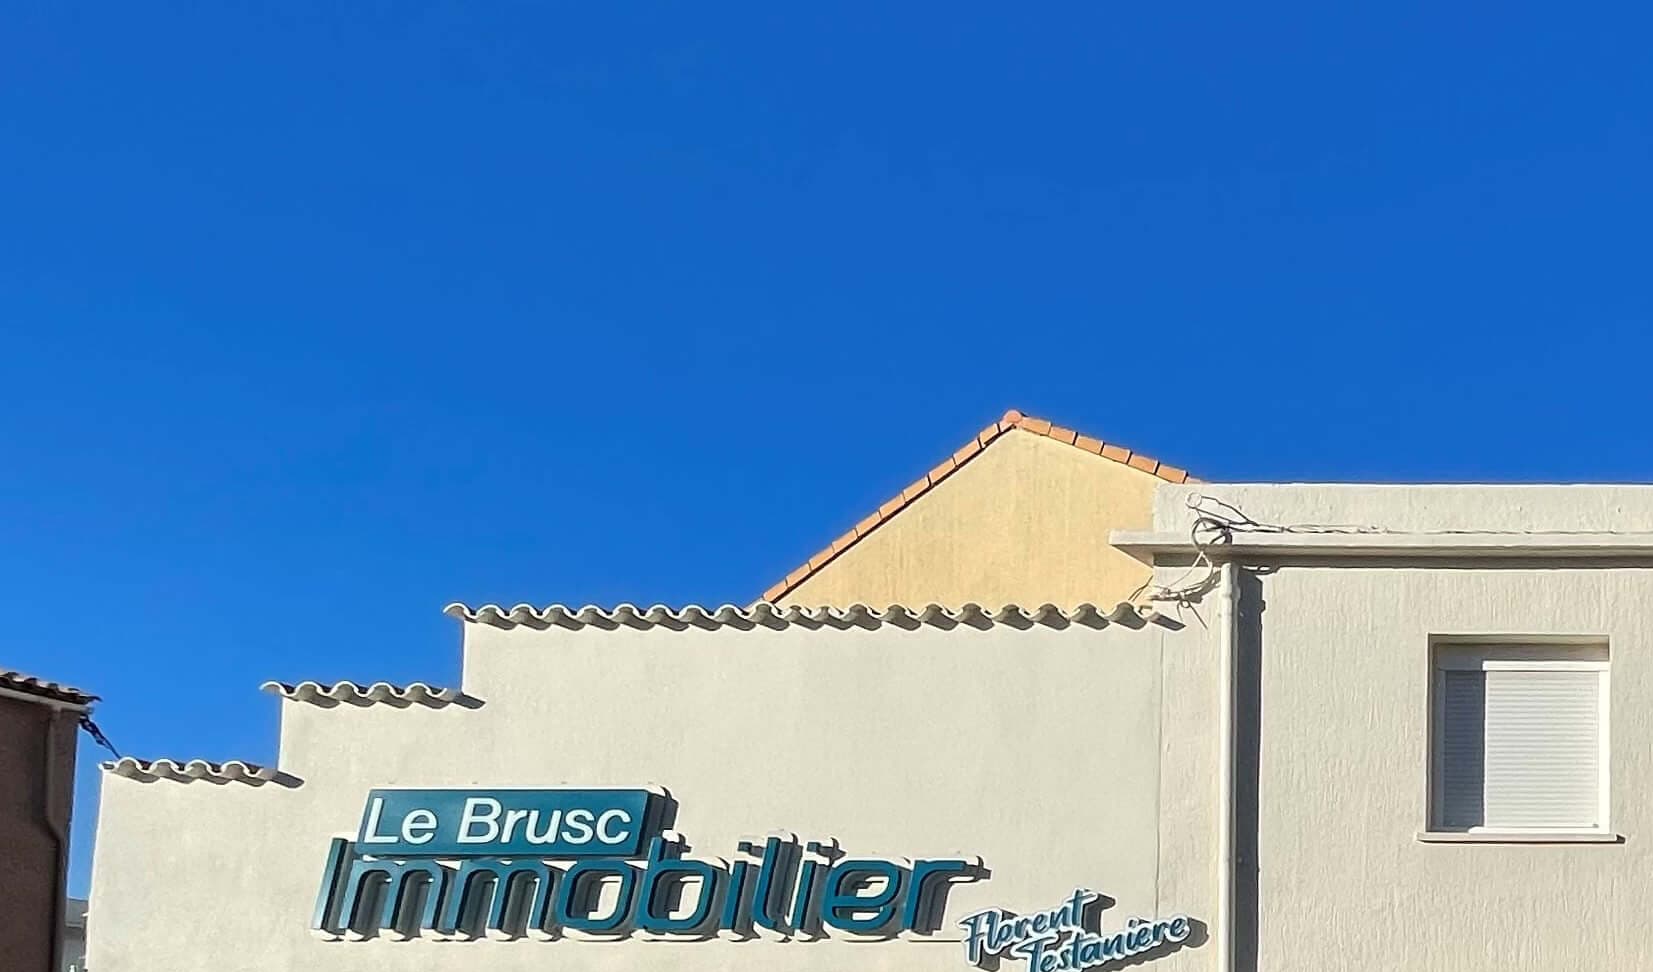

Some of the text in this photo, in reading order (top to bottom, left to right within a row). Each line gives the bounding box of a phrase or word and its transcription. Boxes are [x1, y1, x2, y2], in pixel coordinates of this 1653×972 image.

[362, 797, 632, 845] Le Brusc
[311, 836, 967, 931] Immobilier
[958, 888, 1098, 963] Florent
